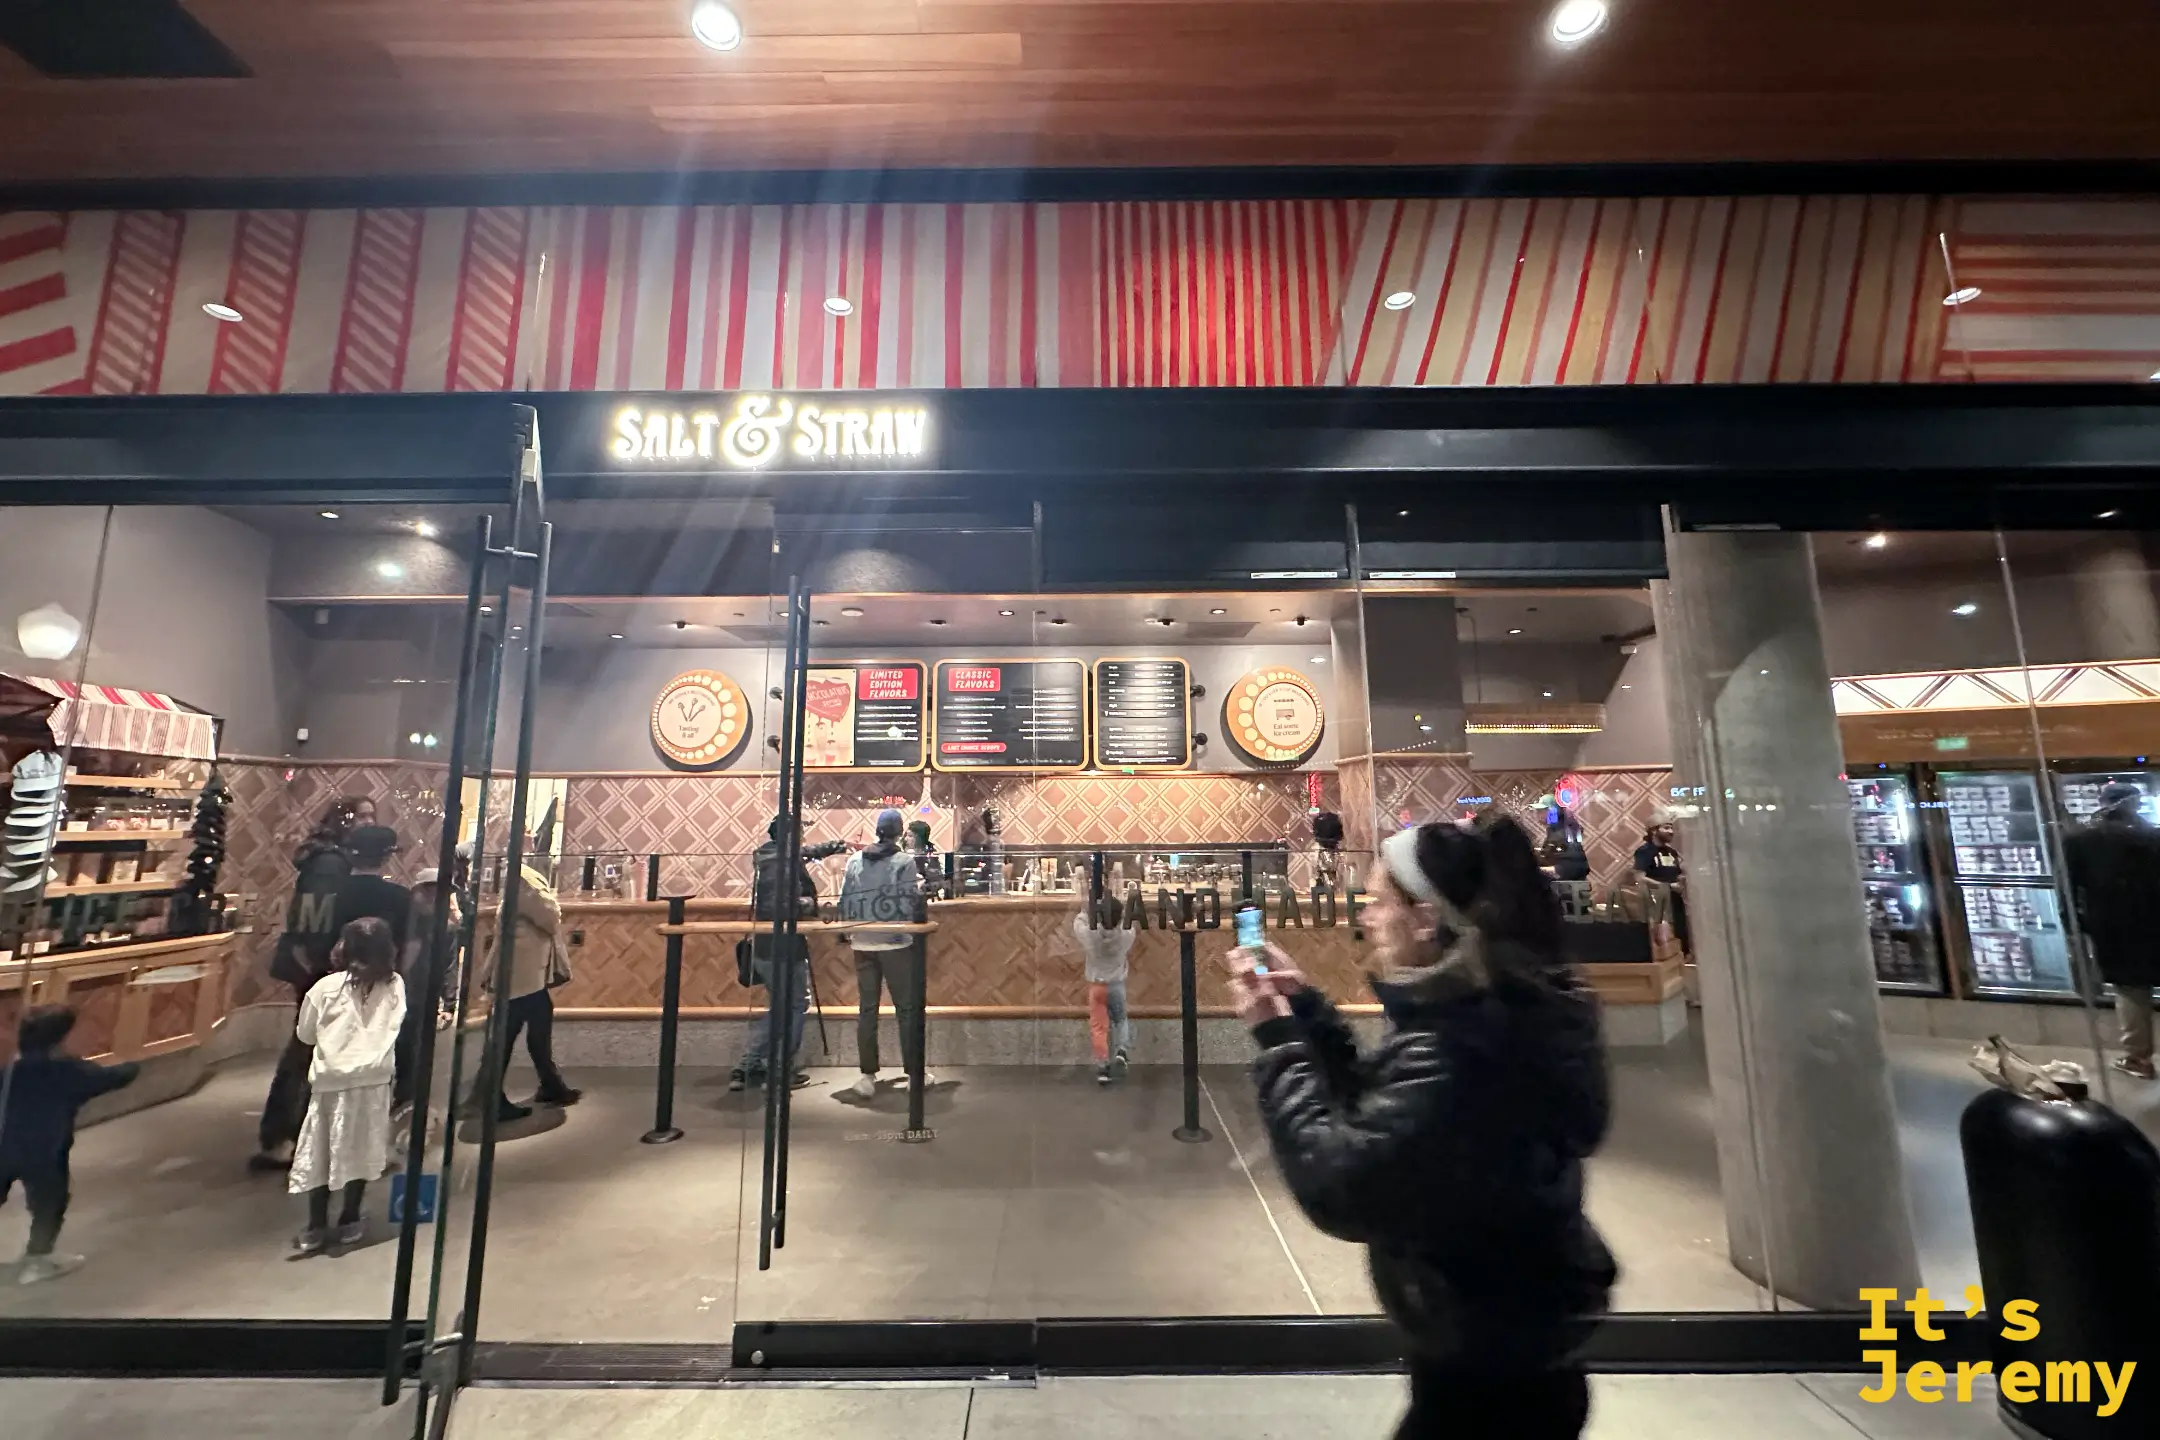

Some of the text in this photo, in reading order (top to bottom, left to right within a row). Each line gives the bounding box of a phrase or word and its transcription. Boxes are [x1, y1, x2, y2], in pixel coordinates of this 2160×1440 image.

[613, 394, 927, 468] SALT & STRAW
[869, 670, 904, 679] LIMITED
[955, 670, 992, 679] CLASSIC
[869, 680, 903, 689] EDITION
[955, 680, 995, 689] FLAVORS
[869, 689, 908, 698] FLAVORS
